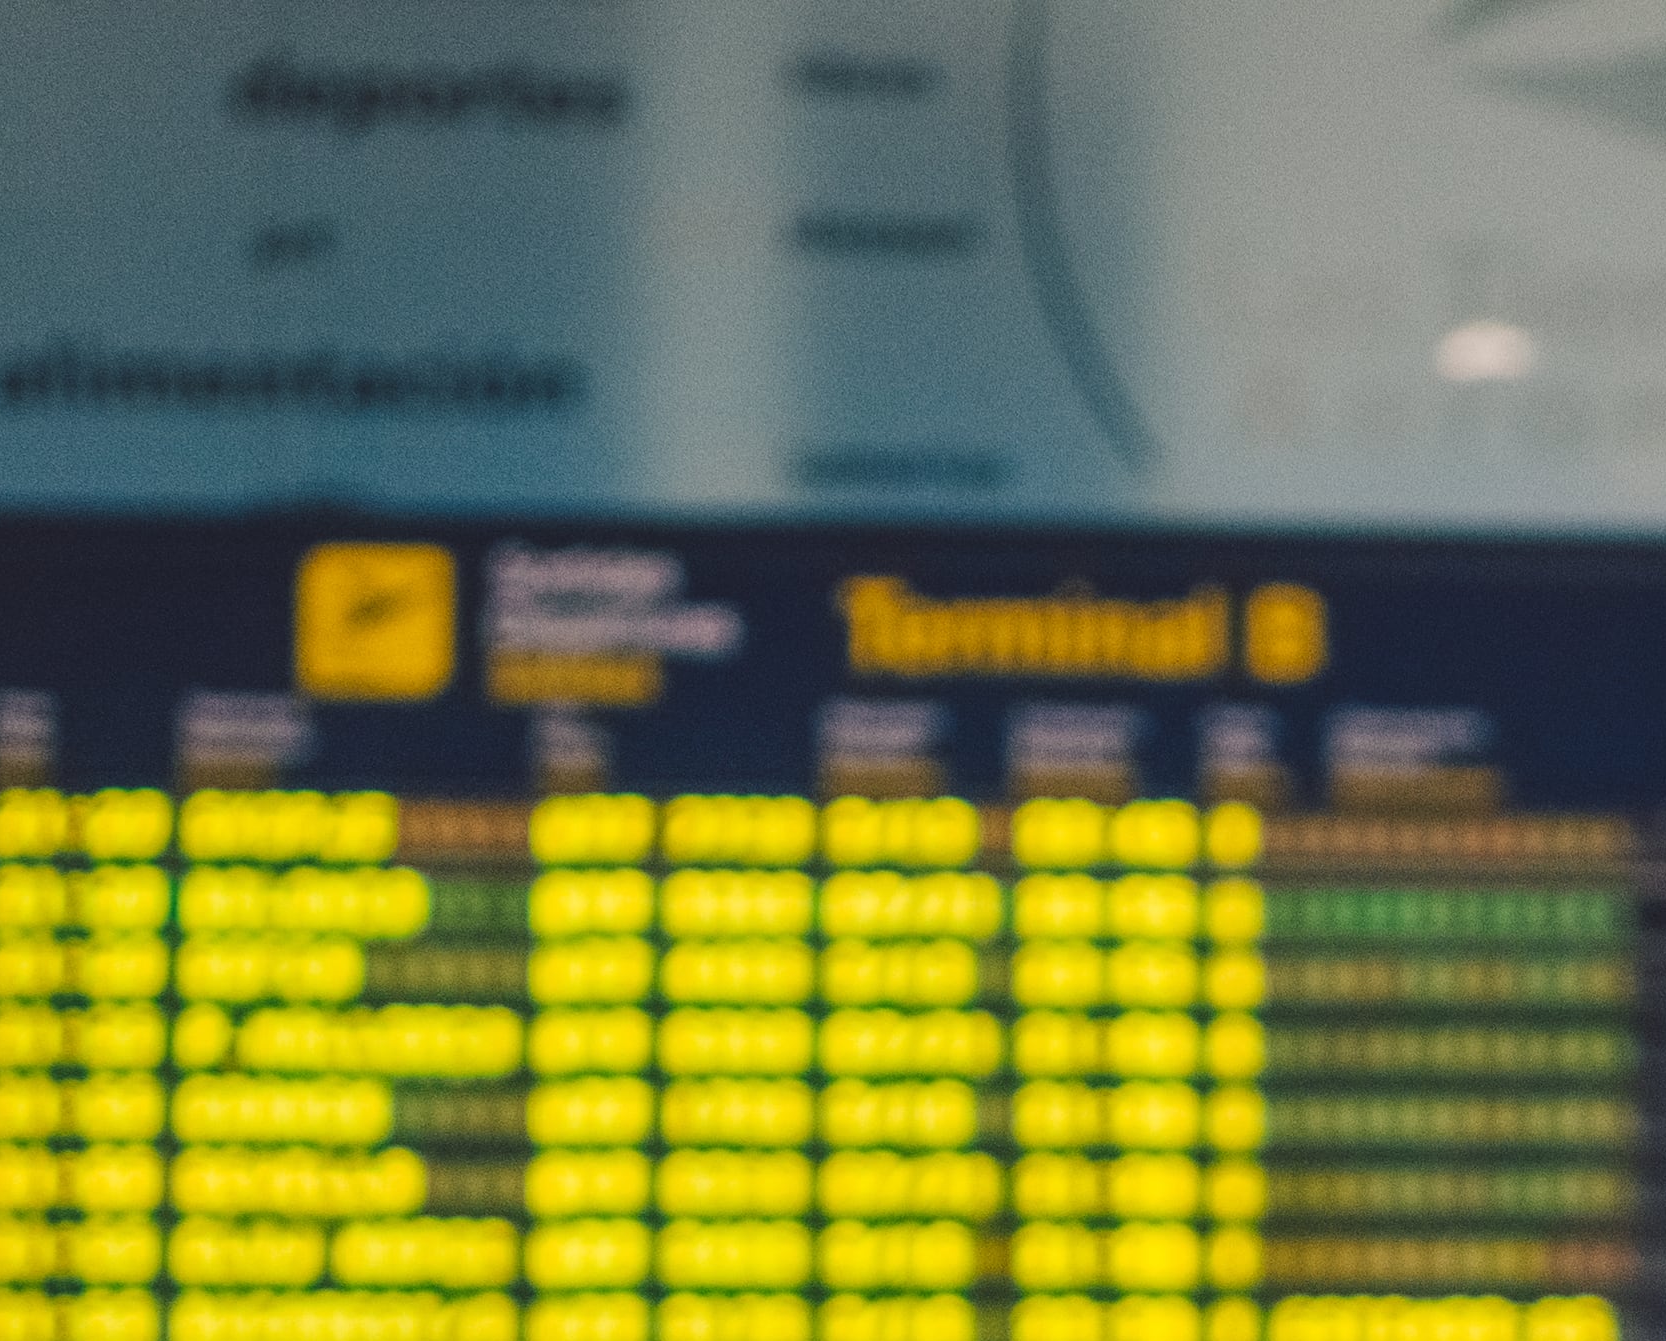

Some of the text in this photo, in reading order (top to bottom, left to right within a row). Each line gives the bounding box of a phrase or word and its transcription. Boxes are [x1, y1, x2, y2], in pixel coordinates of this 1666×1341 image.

[224, 50, 634, 140] deportes
[840, 575, 1229, 677] Terminal
[1246, 582, 1329, 684] B
